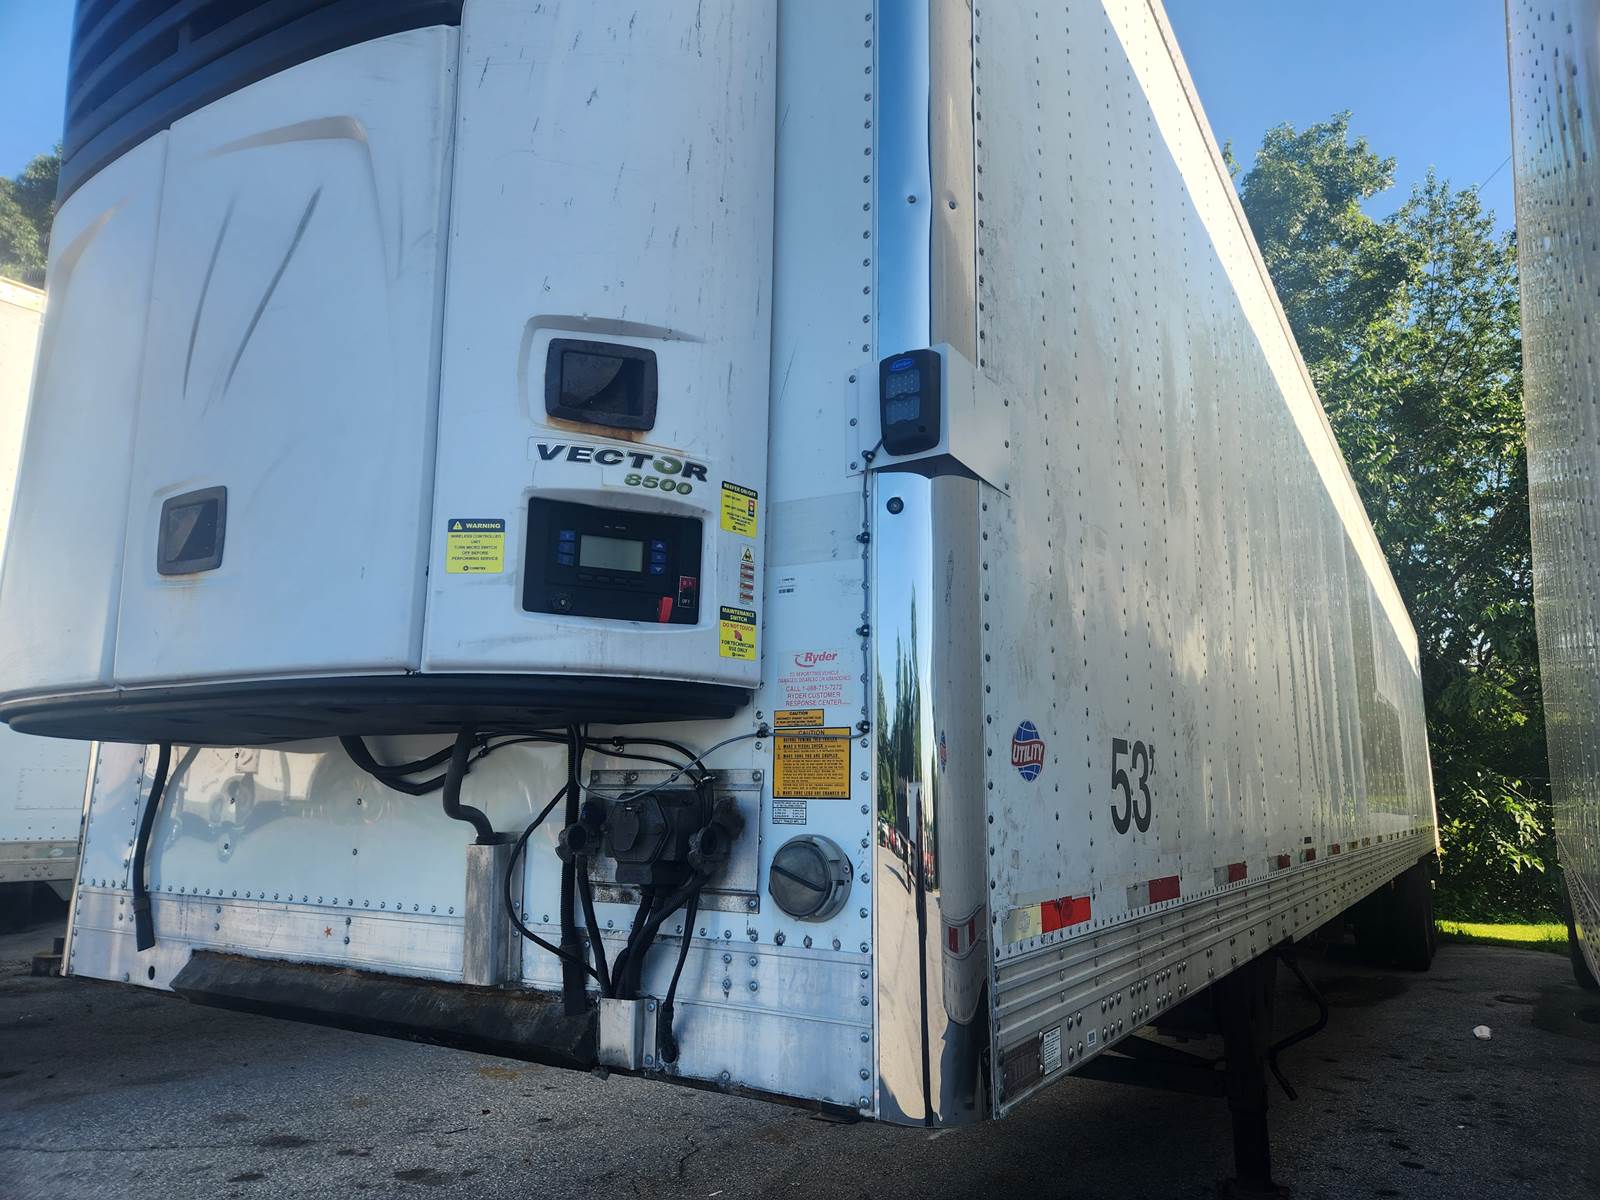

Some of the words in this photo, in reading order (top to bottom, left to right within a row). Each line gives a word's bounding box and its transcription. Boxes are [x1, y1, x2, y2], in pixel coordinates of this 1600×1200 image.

[536, 443, 708, 482] VECTOR
[624, 473, 693, 495] 8500
[722, 608, 754, 617] MAINTENANCE
[730, 614, 748, 622] SWITCH
[804, 651, 838, 664] Ryder
[807, 691, 841, 699] CUSTOMER
[1013, 743, 1044, 764] UTILITY
